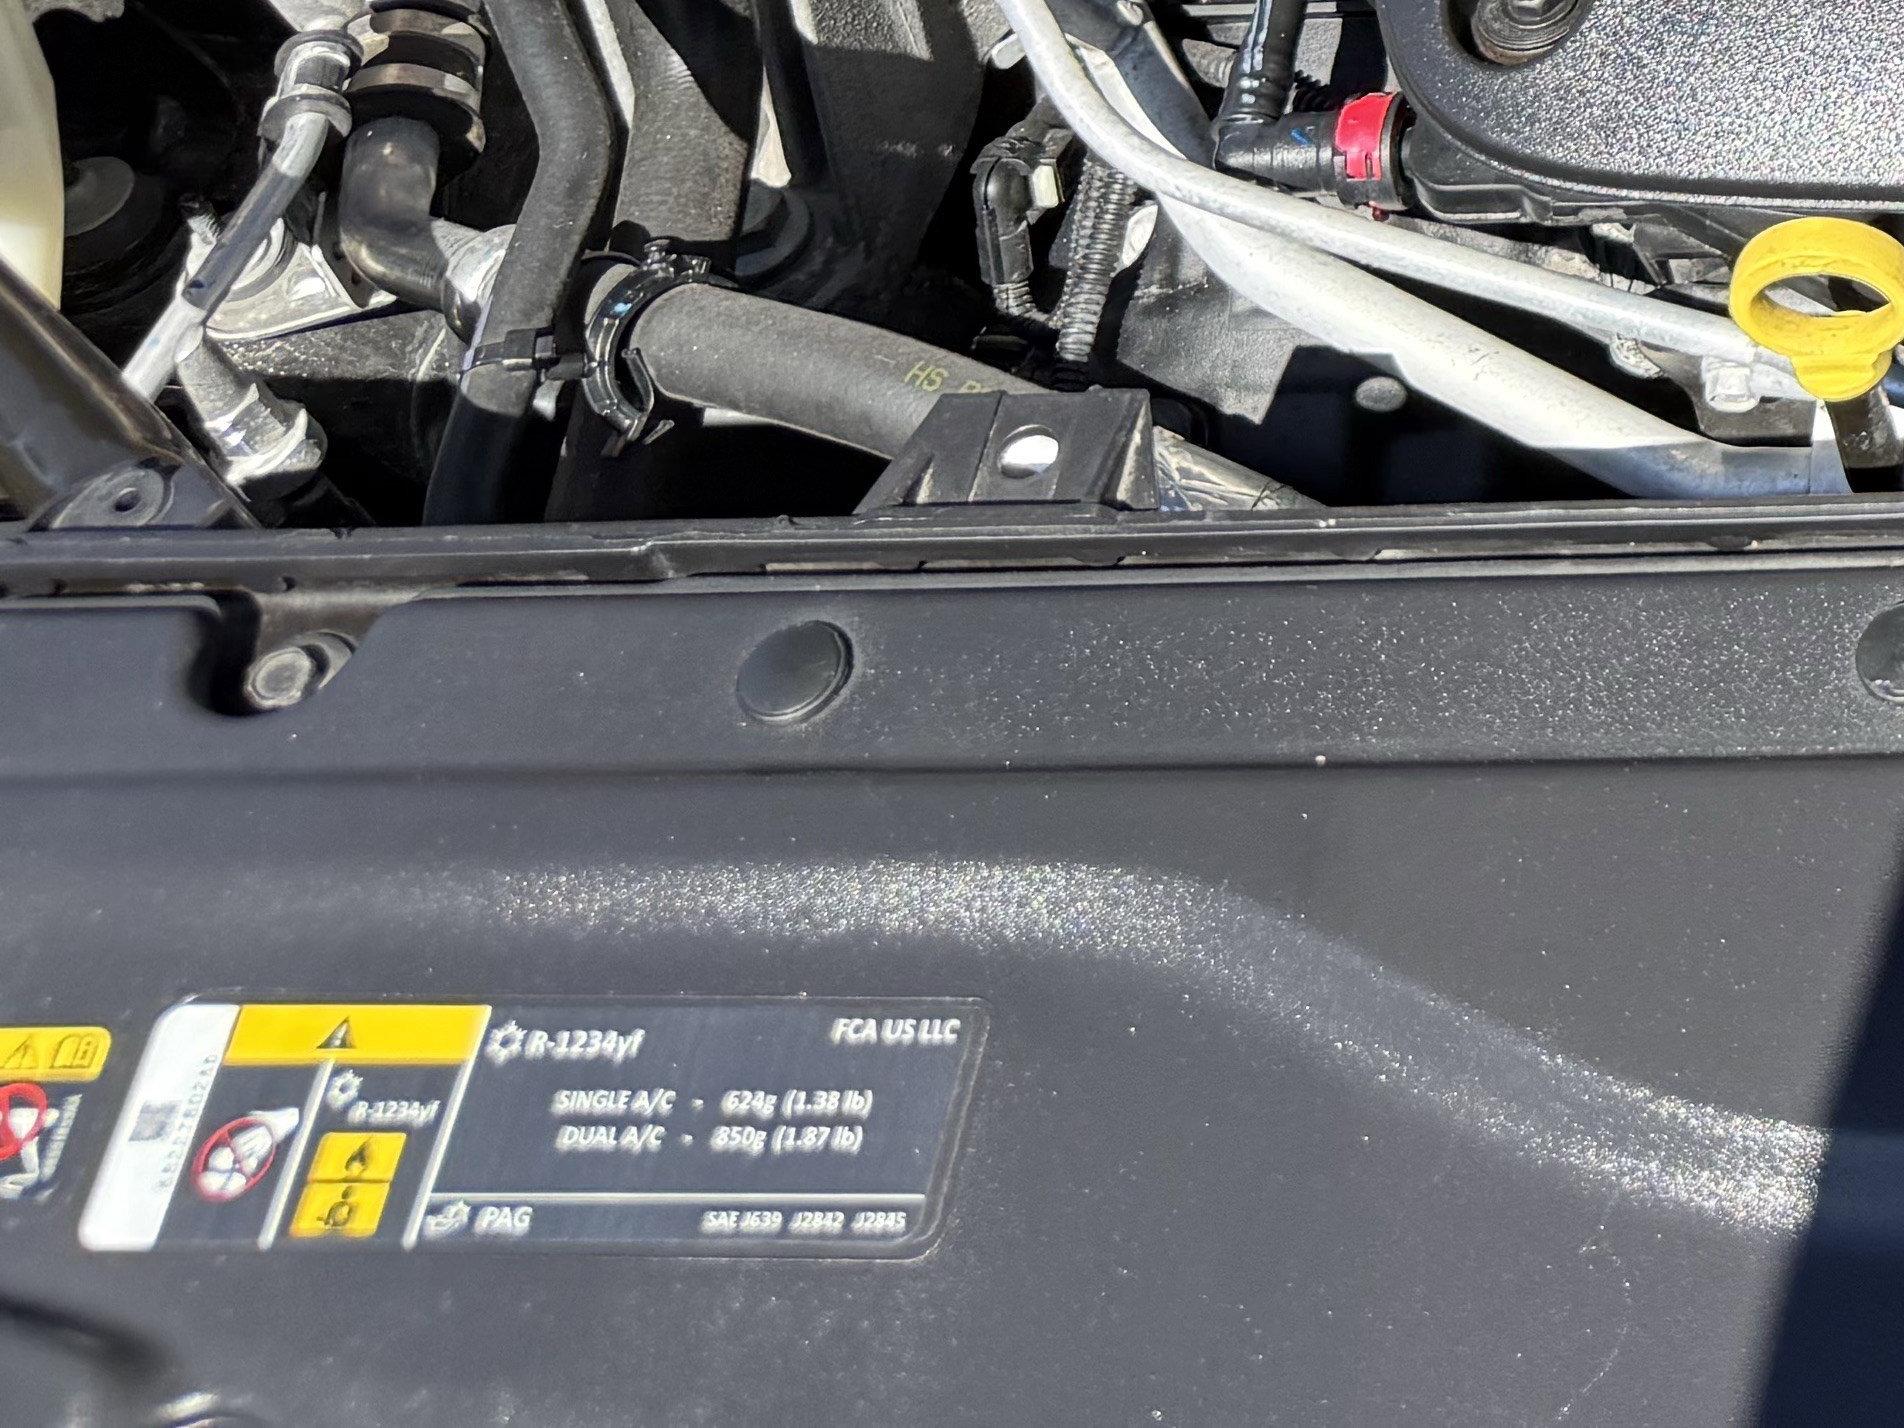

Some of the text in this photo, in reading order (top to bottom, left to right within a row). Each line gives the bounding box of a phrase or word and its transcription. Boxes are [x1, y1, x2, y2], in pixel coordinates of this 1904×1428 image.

[524, 1017, 961, 1065] R-1234yf FCA US LLC
[549, 1088, 873, 1121] SINGLE A/C 624g (1.38 lb)
[552, 1124, 864, 1156] DUAL A/C 850g (1.87 lb)
[477, 1206, 533, 1236] PAG
[698, 1210, 740, 1235] SAE
